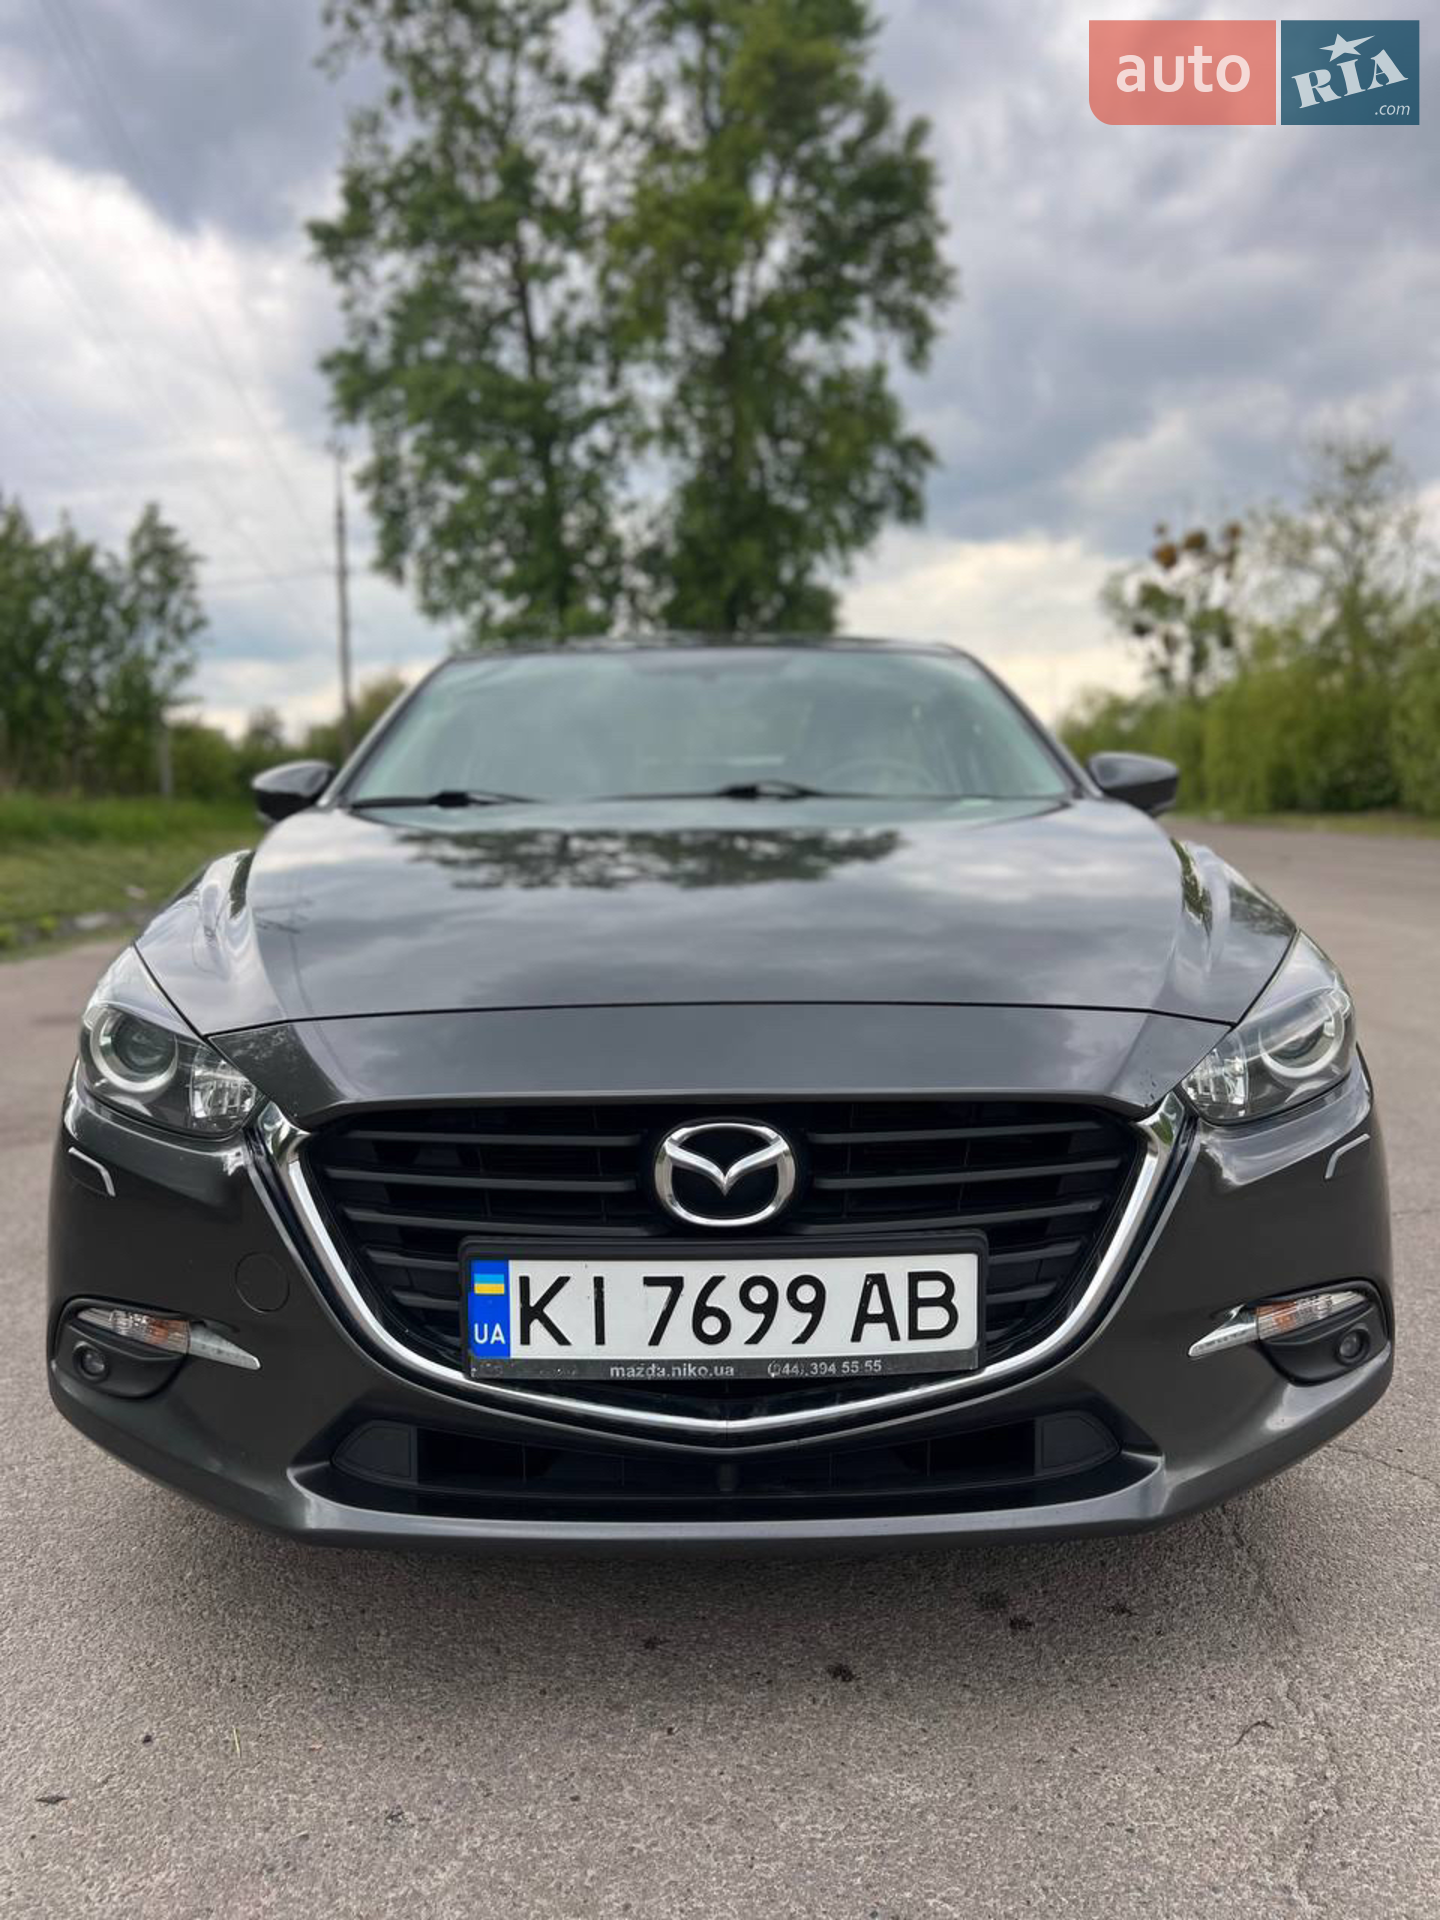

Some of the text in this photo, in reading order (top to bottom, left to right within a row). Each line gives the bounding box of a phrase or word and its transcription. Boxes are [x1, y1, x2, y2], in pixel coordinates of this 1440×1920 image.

[518, 1270, 960, 1346] KI 7699 AB
[474, 1323, 505, 1345] UA
[609, 1362, 735, 1379] mazda.niko.ua
[810, 1361, 837, 1375] 394
[841, 1360, 859, 1374] 55
[864, 1359, 882, 1373] 55
